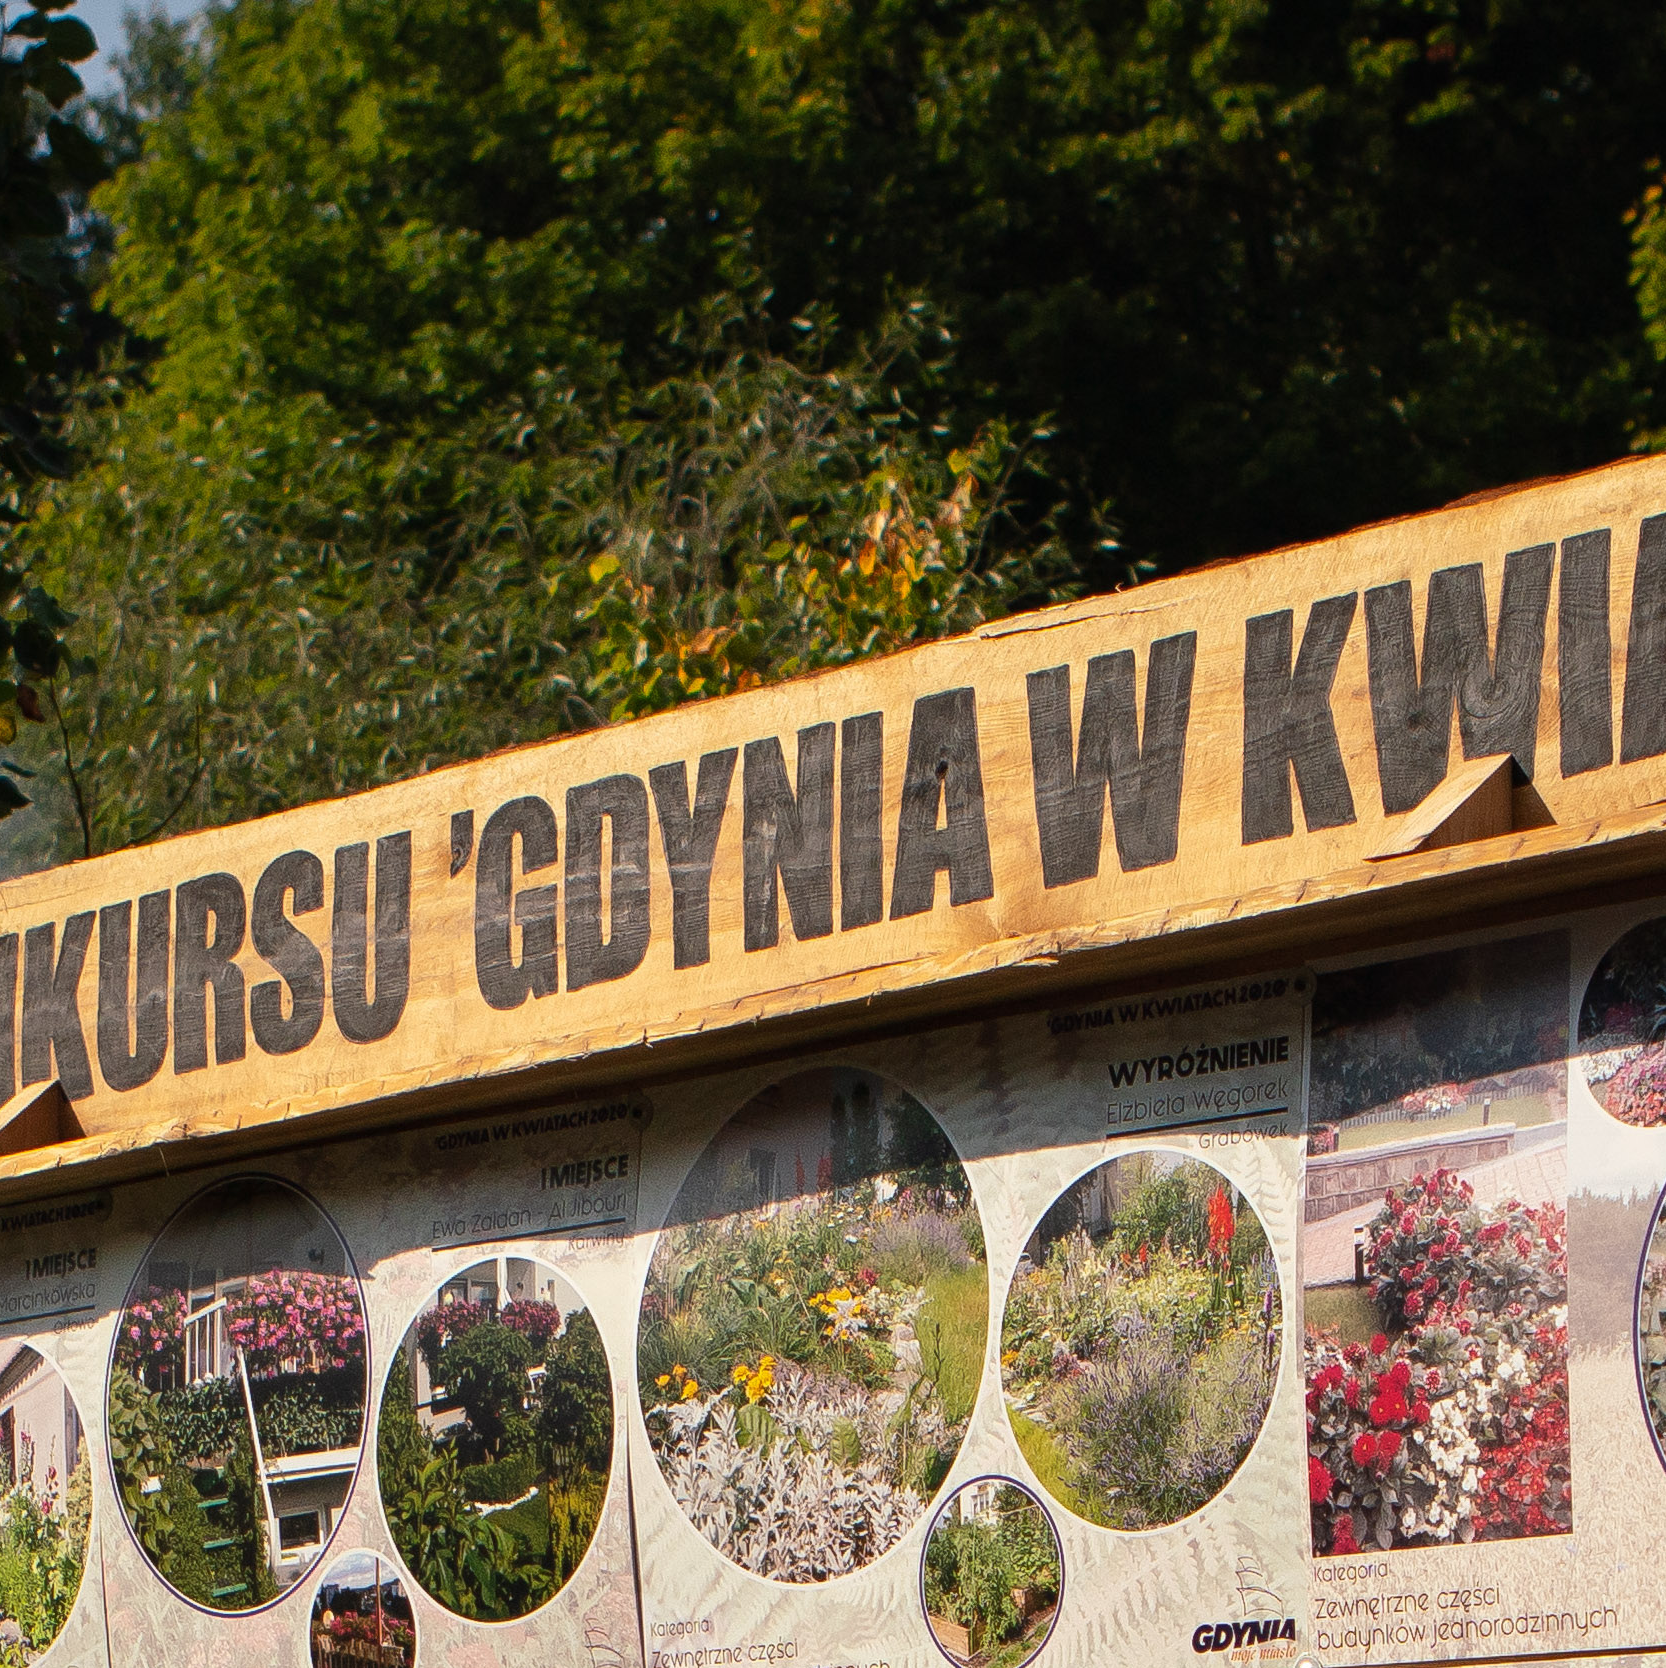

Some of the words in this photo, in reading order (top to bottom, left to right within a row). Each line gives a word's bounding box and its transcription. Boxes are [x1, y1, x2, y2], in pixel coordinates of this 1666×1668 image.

[450, 687, 993, 1008] 'GDYNIA
[1027, 630, 1195, 882] W
[1119, 1004, 1139, 1023] W
[1142, 989, 1236, 1020] KWIATACH
[1108, 1036, 1288, 1088] WYRÓŻNIENIE
[1108, 1094, 1185, 1125] Elżbieta
[1193, 1077, 1288, 1113] Węgorek
[493, 1124, 509, 1141] W
[512, 1111, 588, 1138] KWIATACH
[1199, 1121, 1288, 1150] Grabówek
[541, 1169, 547, 1190] I
[550, 1155, 629, 1189] MIEJSCE
[433, 1220, 466, 1239] Ewa
[568, 1230, 624, 1251] Karwiny
[34, 1248, 97, 1278] MIEJSCE
[1315, 1593, 1428, 1620] Zewnętrzne
[1437, 1583, 1499, 1614] części
[1191, 1619, 1295, 1654] GDYNIA
[1317, 1623, 1425, 1653] budynków
[1431, 1607, 1618, 1649] jednorodzinnych
[748, 1636, 799, 1664] części
[1230, 1646, 1256, 1663] moje
[1259, 1643, 1297, 1661] miasto
